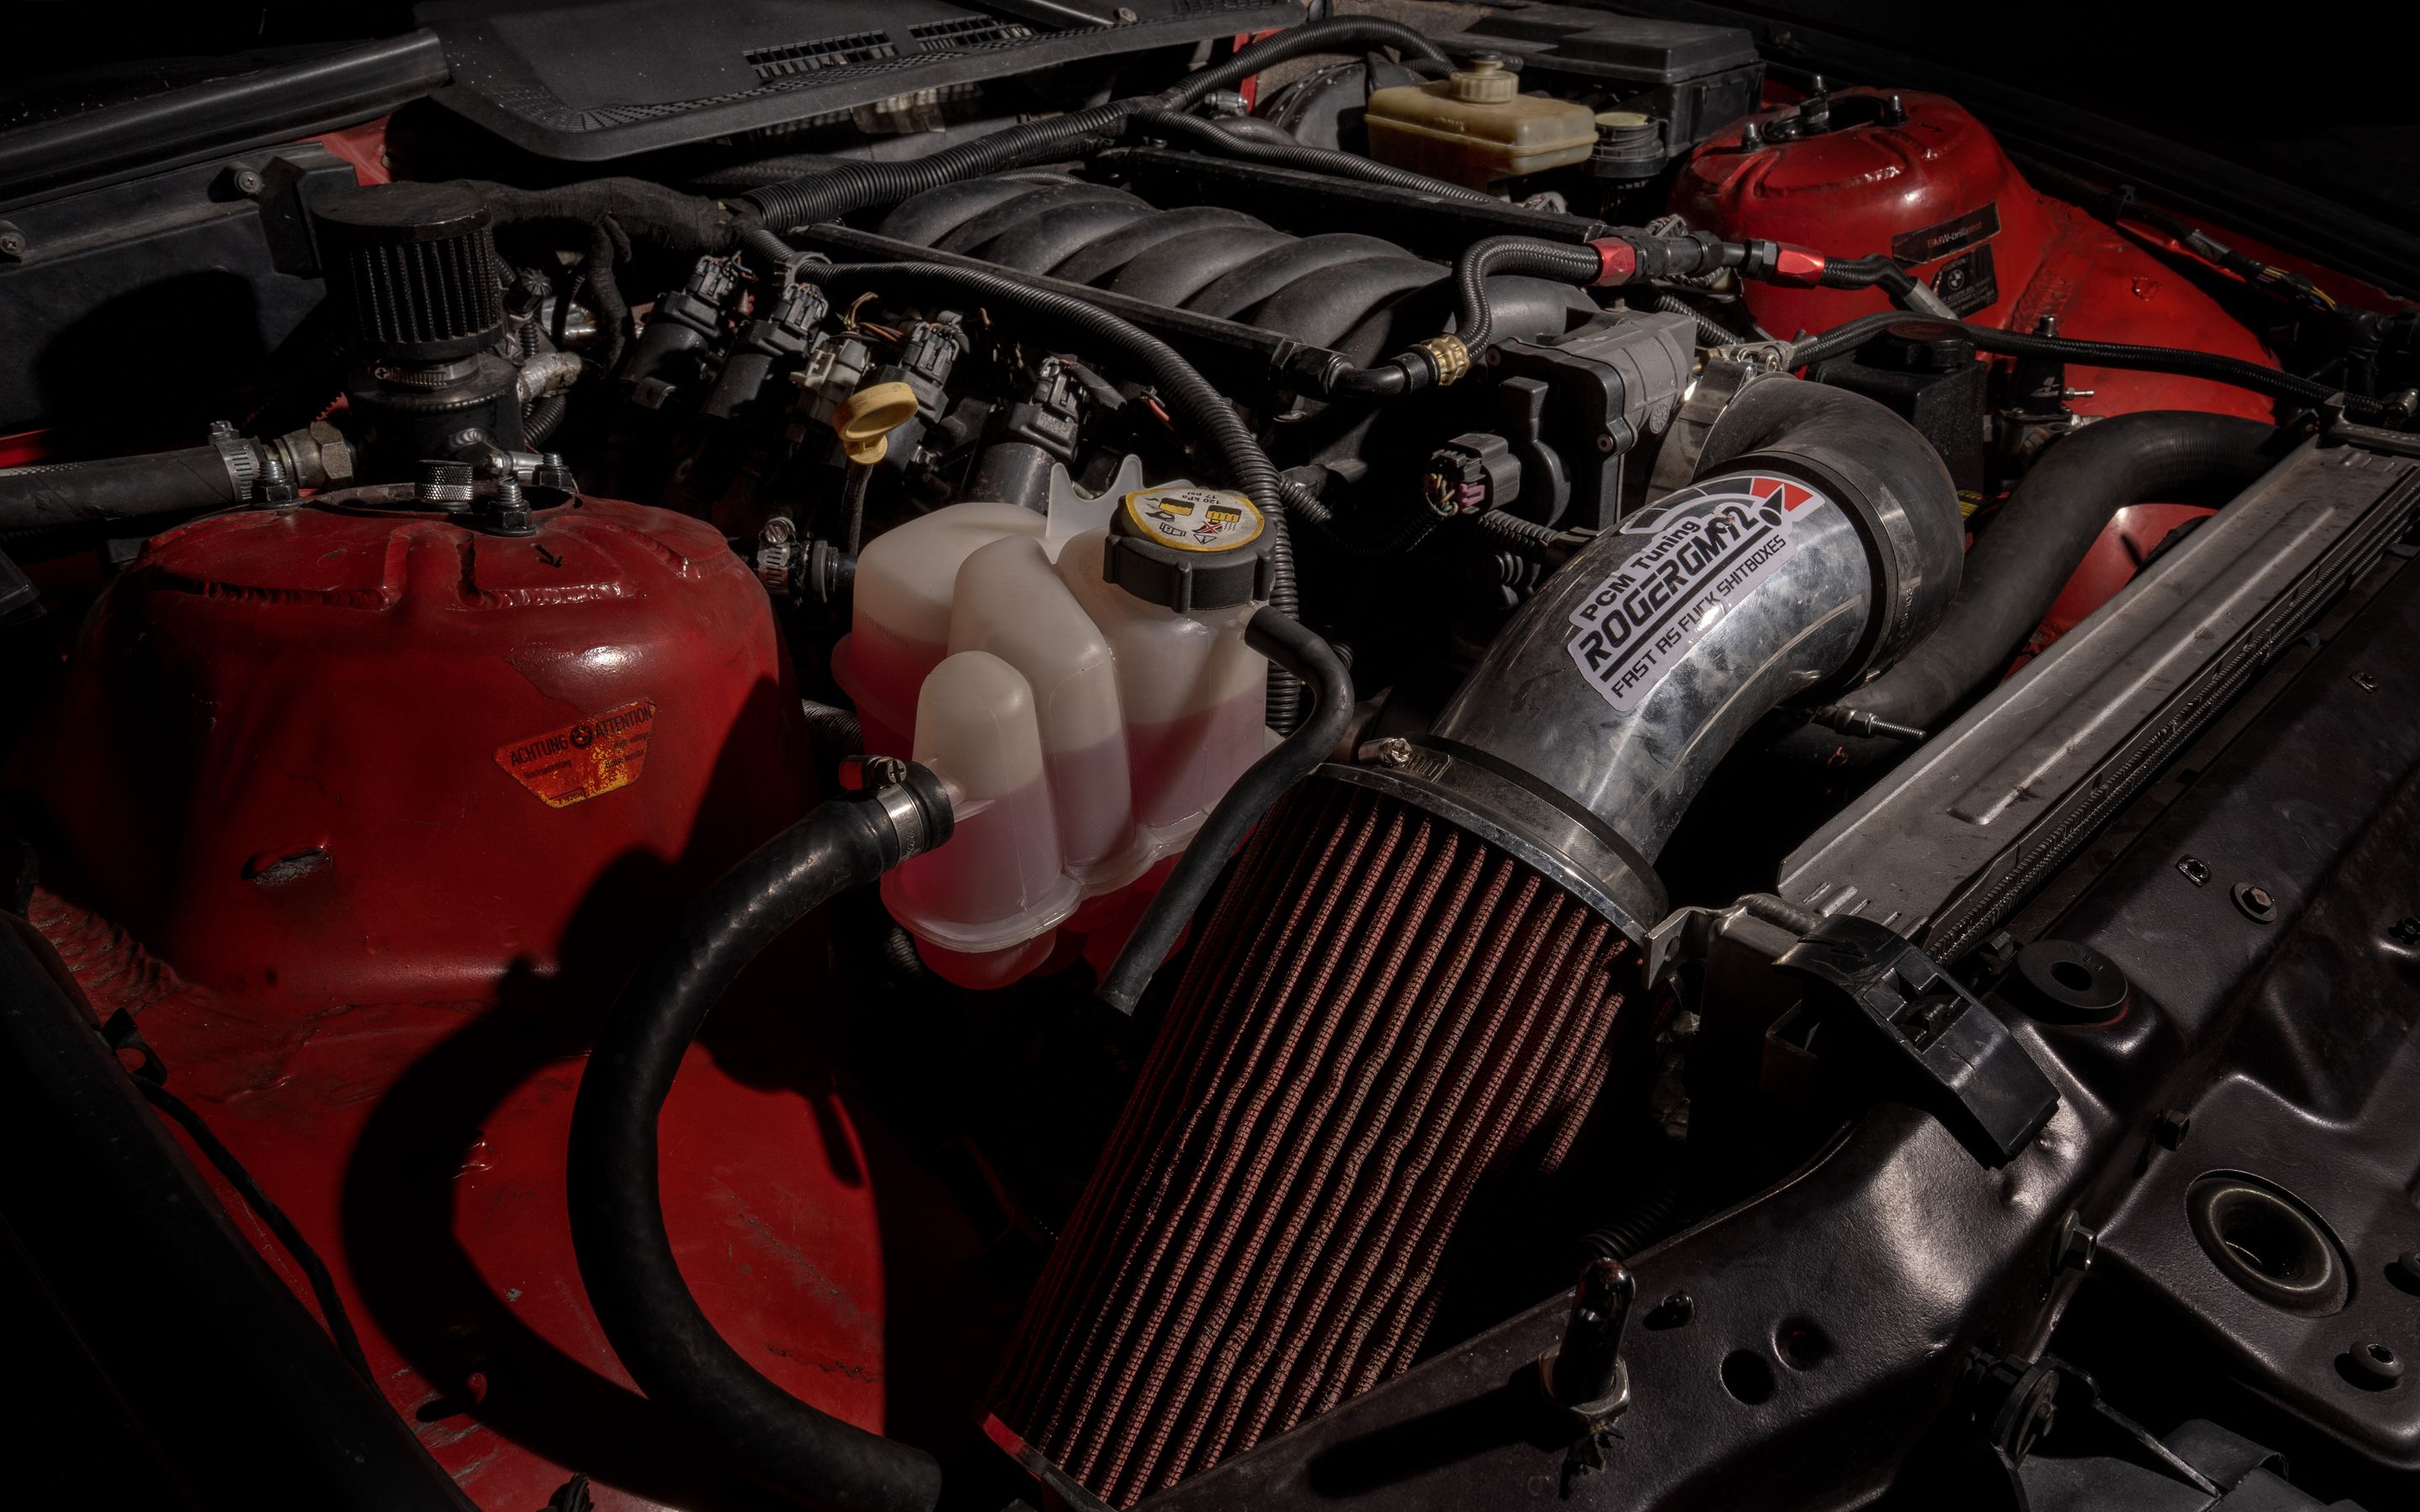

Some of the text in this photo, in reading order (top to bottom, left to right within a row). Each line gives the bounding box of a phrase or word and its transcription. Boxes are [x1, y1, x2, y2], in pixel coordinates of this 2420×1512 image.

[1579, 519, 1701, 622] PCM Tuning
[1611, 649, 1660, 699] FAST
[1655, 627, 1682, 655] AS
[1716, 534, 1786, 597] SHITBOXES
[511, 706, 653, 766] ACHTUNG ATTENTION
